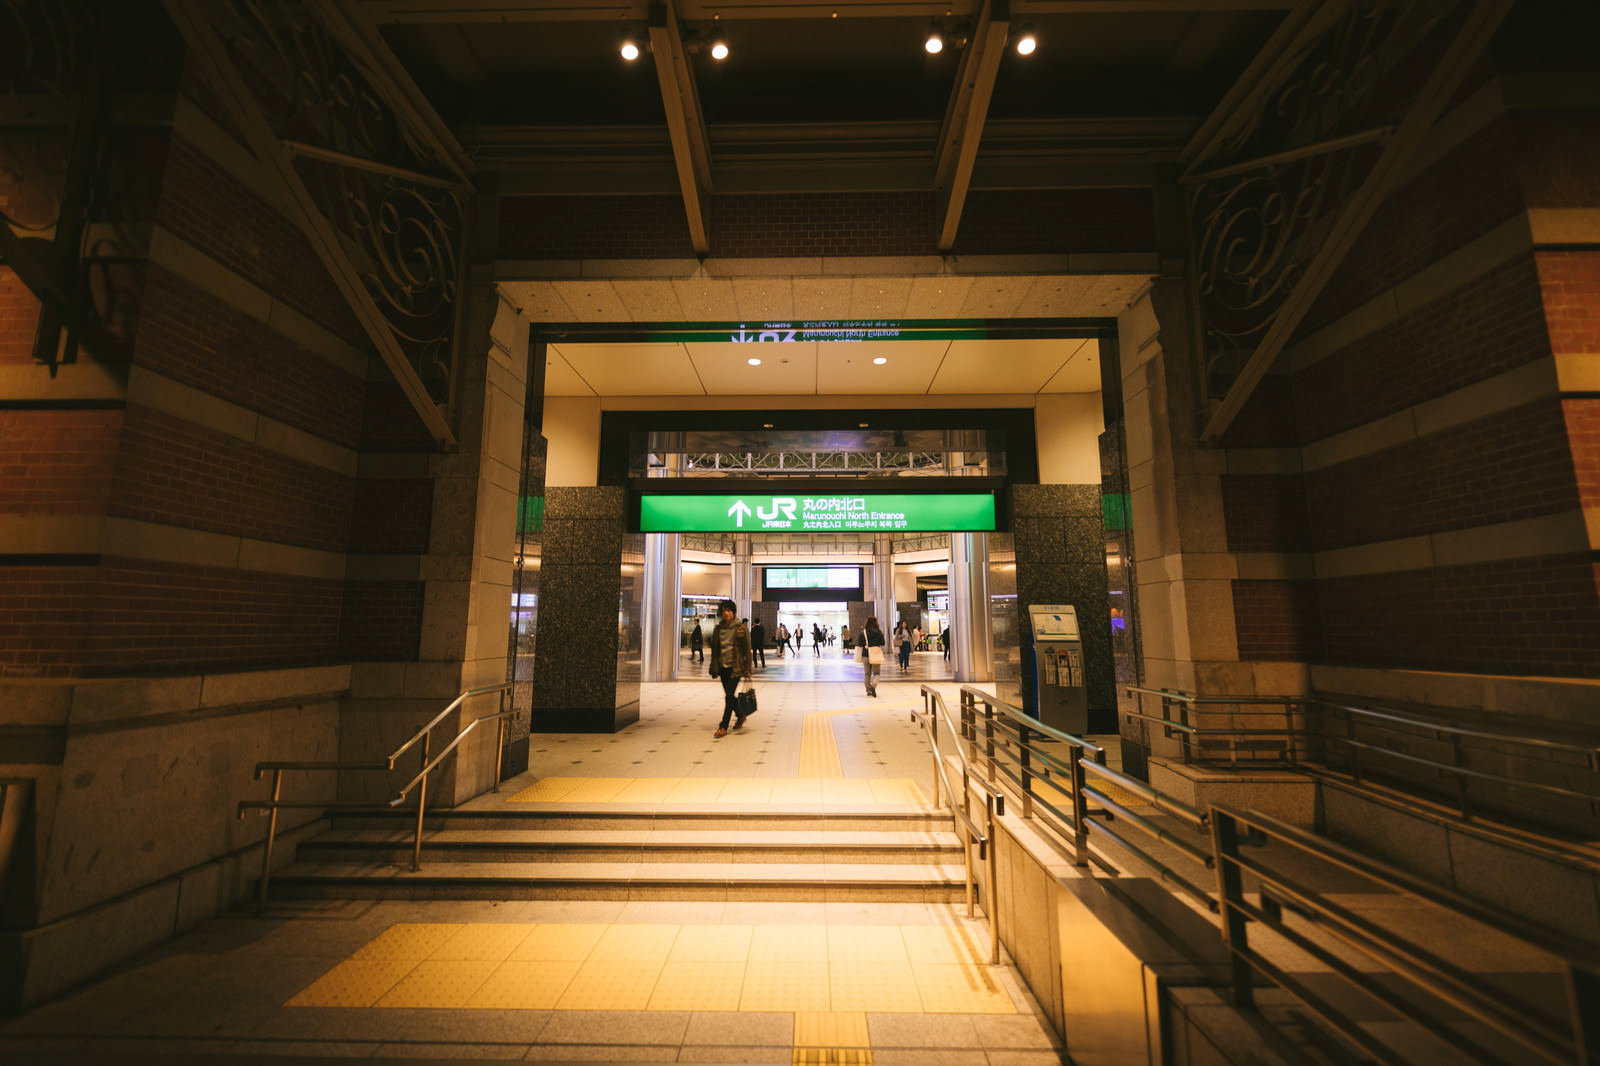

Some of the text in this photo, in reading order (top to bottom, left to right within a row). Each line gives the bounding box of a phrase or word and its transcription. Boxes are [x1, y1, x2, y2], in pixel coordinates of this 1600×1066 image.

[757, 498, 797, 520] JR
[803, 498, 865, 511] 丸の内北口
[803, 512, 905, 520] Marunouchi North Entrance
